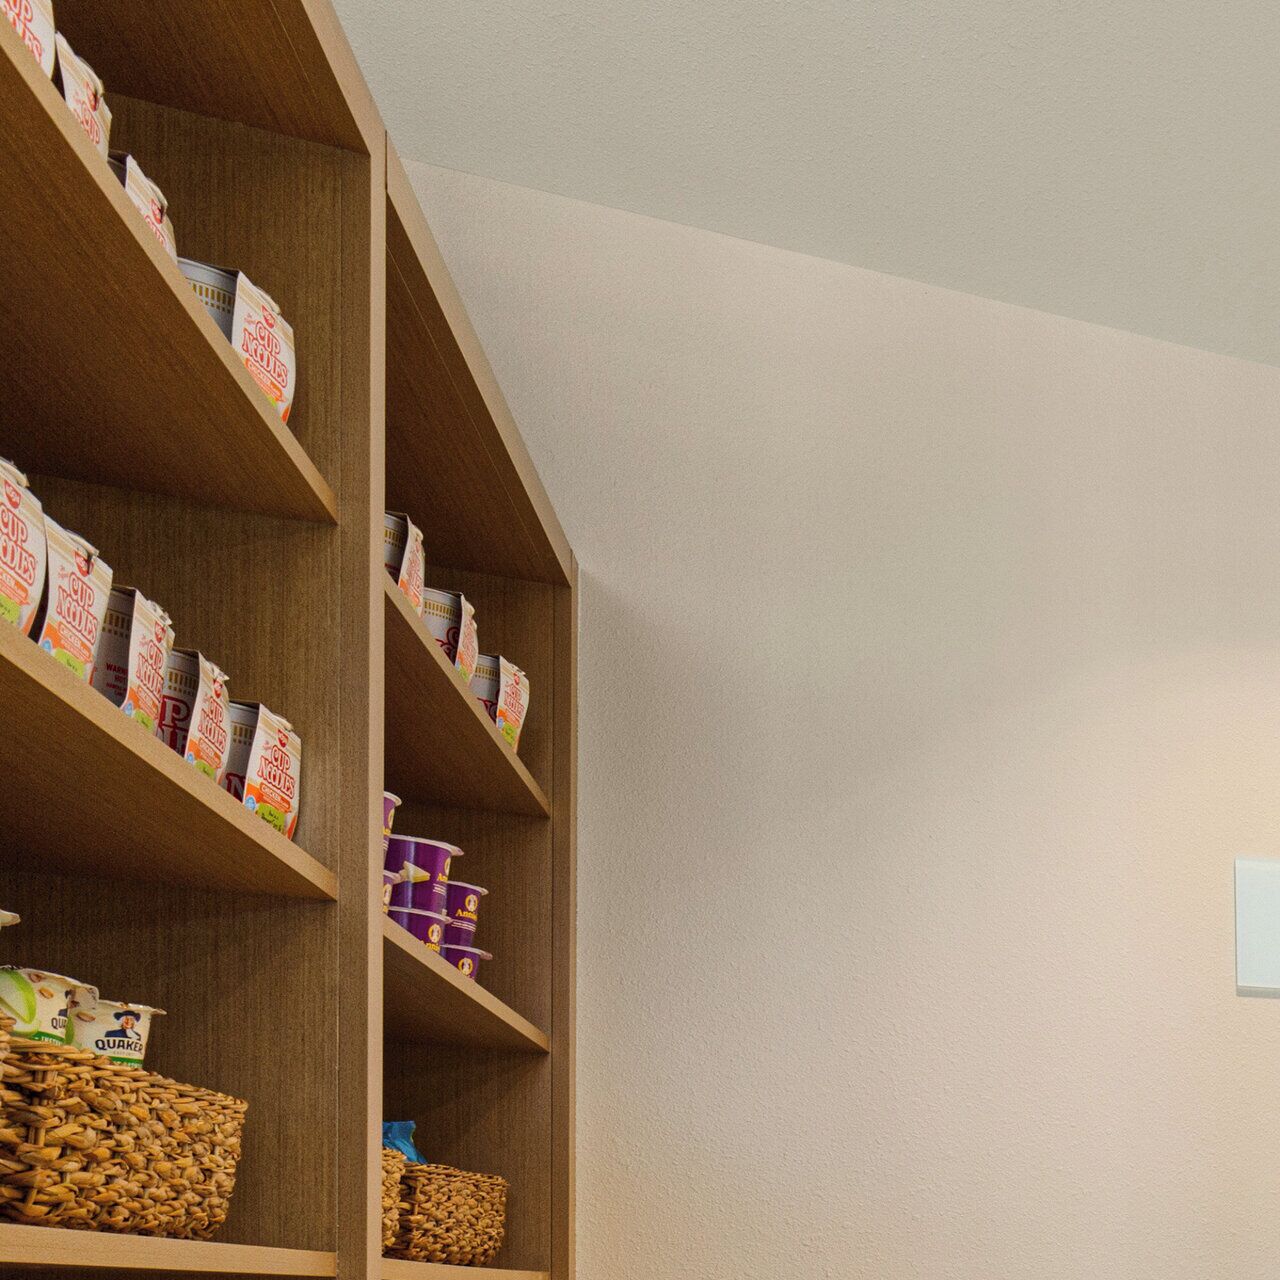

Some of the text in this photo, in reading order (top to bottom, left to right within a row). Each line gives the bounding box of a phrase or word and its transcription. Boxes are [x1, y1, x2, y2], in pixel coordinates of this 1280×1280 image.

[255, 319, 281, 356] CUP
[242, 328, 288, 389] NOODLES
[0, 504, 28, 547] CUP
[69, 572, 95, 612] CUP
[56, 585, 98, 646] NOODLES
[106, 662, 128, 673] WARN
[147, 640, 164, 670] CUP
[207, 697, 224, 725] CUP
[199, 708, 227, 754] NOODLES
[271, 744, 291, 772] CUP
[257, 755, 295, 800] NOODLES
[95, 1037, 144, 1053] QUAKER
